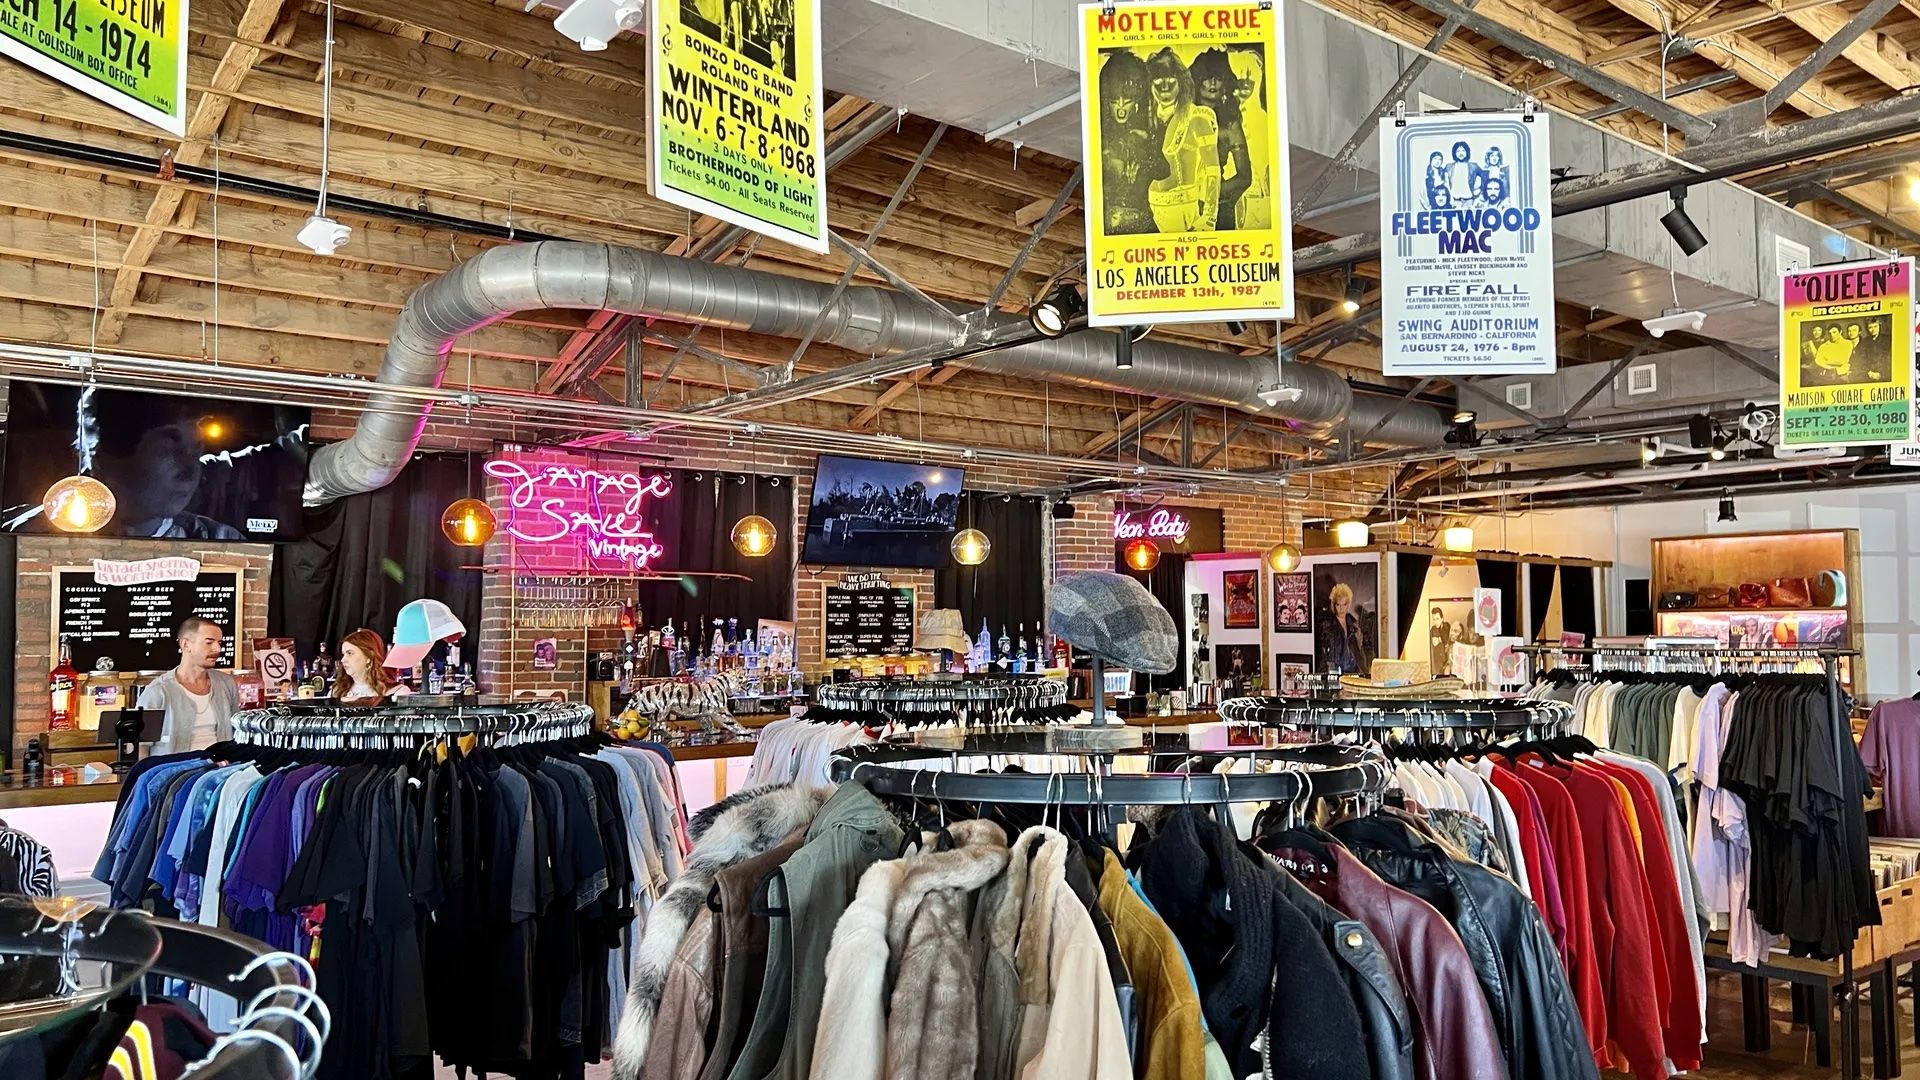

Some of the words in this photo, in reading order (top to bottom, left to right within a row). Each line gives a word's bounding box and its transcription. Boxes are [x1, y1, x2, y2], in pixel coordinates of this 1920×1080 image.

[1098, 10, 1192, 33] MOTLEY
[1203, 8, 1262, 29] CRUE
[99, 18, 152, 78] 1974
[1124, 34, 1146, 42] GIRLS
[22, 21, 35, 38] AT
[38, 29, 84, 63] COLISEUM
[87, 54, 105, 74] BOX
[109, 67, 138, 90] OFFICE
[685, 34, 728, 65] BONZO
[733, 58, 758, 80] DOG
[763, 73, 793, 97] BAND
[701, 60, 748, 92] ROLAND
[754, 85, 781, 108] KIRK
[662, 90, 708, 135] NOV.
[668, 62, 810, 149] WINTERLAND
[713, 142, 719, 153] 3
[723, 146, 747, 165] DAYS
[751, 158, 773, 175] ONLY
[668, 140, 760, 187] BROTHERHOOD
[765, 180, 779, 194] OF
[783, 185, 813, 208] LIGHT
[667, 158, 700, 181] Tickets
[704, 173, 731, 192] $4.00
[738, 187, 750, 201] All
[753, 192, 776, 210] Seats
[779, 202, 815, 224] Reserved
[1392, 208, 1541, 236] FLEETWOOD
[1124, 247, 1166, 263] GUNS
[1197, 244, 1250, 260] ROSES
[1438, 229, 1492, 255] MAC
[1096, 269, 1125, 289] LOS
[1135, 264, 1199, 287] ANGELES
[1209, 262, 1280, 283] COLISEUM
[1116, 288, 1186, 301] DECEMBER
[1193, 286, 1225, 299] 13th,
[1231, 285, 1261, 297] 1987
[1406, 285, 1460, 297] FIRE
[1466, 283, 1529, 295] FALL
[1813, 307, 1827, 316] in
[1828, 301, 1879, 314] concert
[1398, 319, 1443, 332] SWING
[1450, 317, 1539, 331] AUDITORIUM
[1400, 333, 1418, 341] SAN
[1421, 332, 1478, 340] BERNARDINO
[1485, 331, 1537, 339] CALIFORNIA
[1401, 344, 1448, 353] AUGUST
[1450, 343, 1469, 353] 24,
[1474, 343, 1500, 352] 1976
[1511, 342, 1536, 353] 8pm
[1788, 391, 1825, 407] MADISON
[1831, 388, 1864, 404] SQUARE
[1870, 386, 1906, 402] GARDEN
[1786, 416, 1825, 430] SEPT.
[1829, 413, 1871, 427] 28-30,
[1876, 412, 1907, 425] 1980
